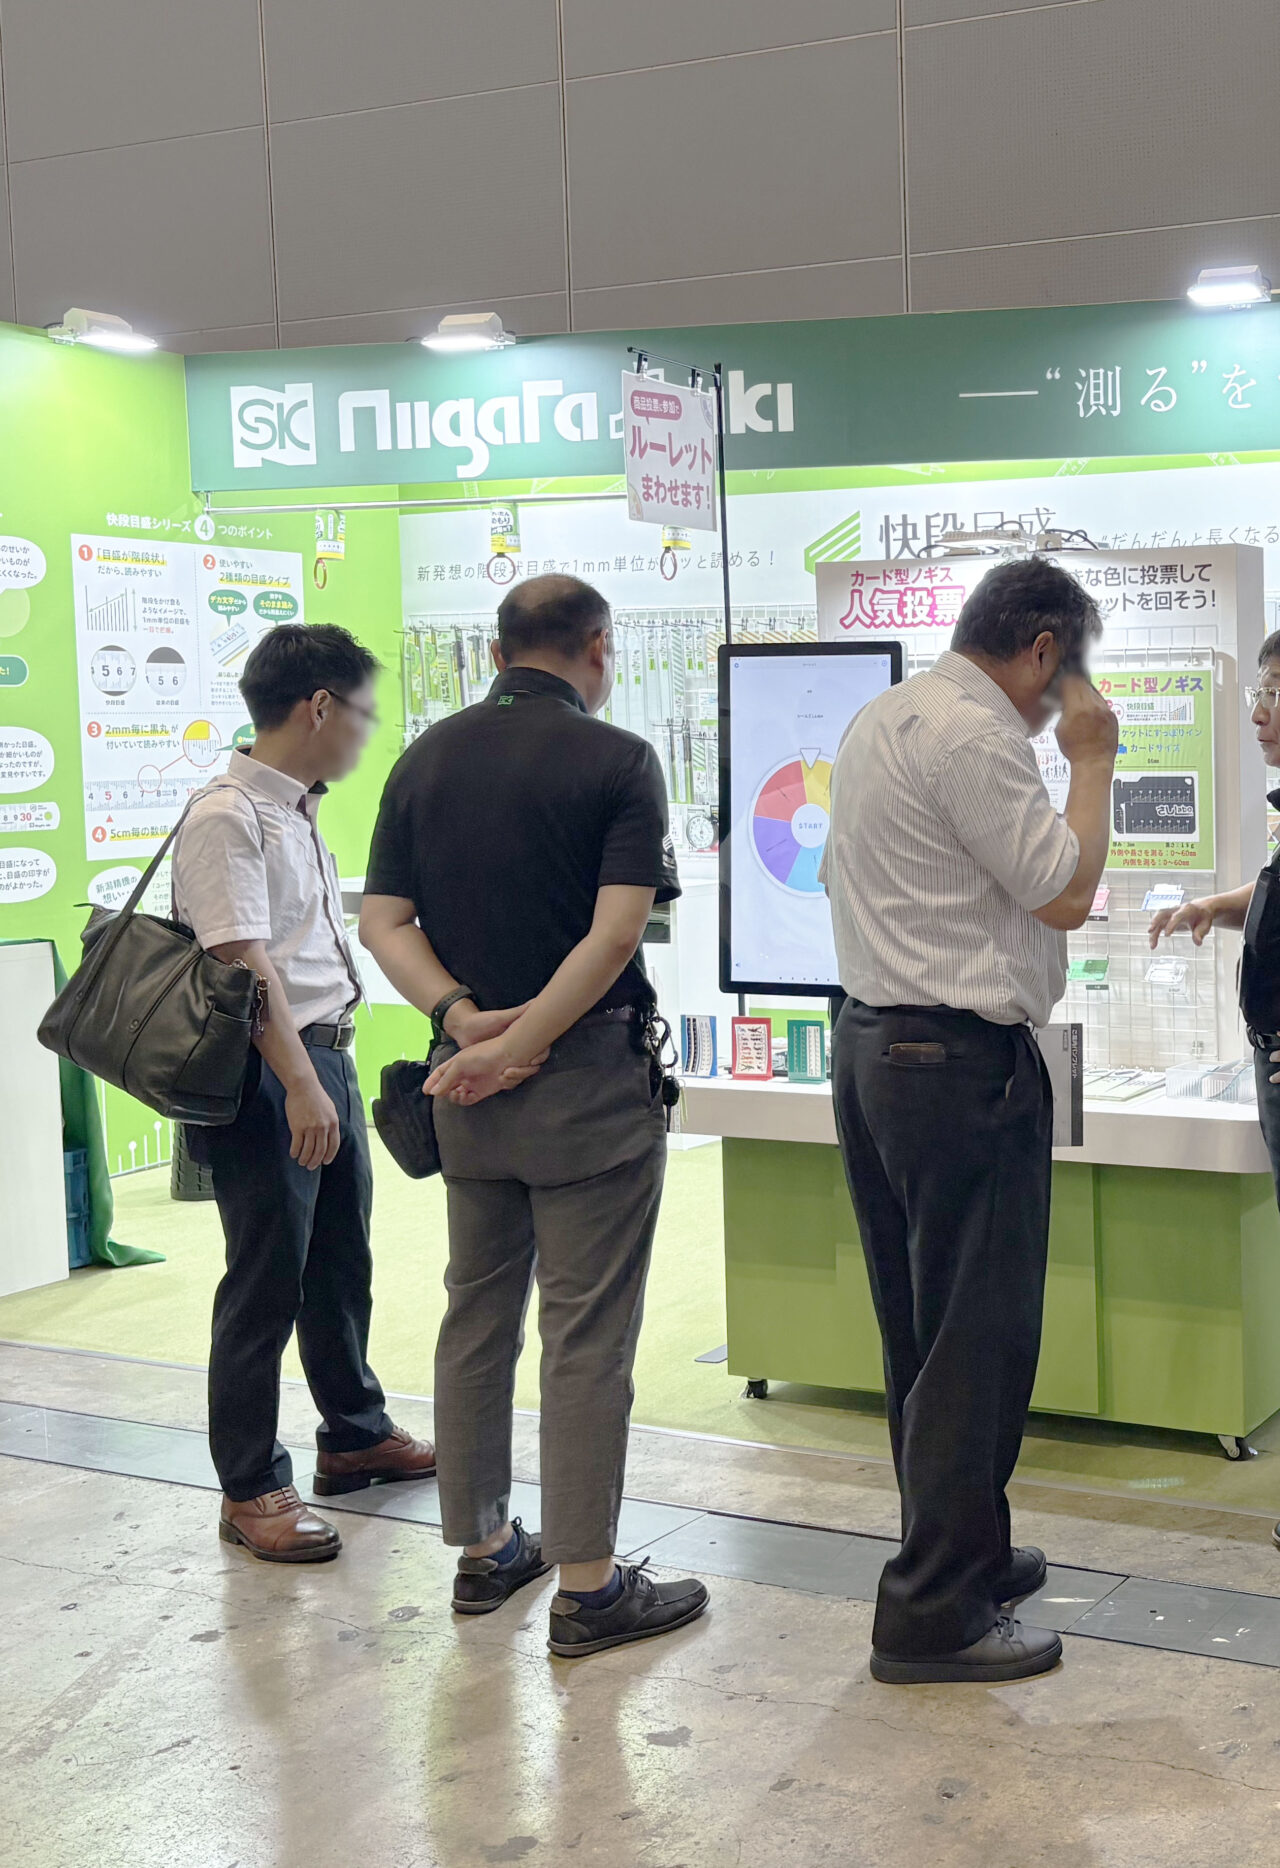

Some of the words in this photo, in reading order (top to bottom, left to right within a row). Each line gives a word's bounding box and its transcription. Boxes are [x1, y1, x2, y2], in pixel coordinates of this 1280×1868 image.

[629, 425, 713, 475] ルーレット
[106, 512, 192, 533] 快段目盛シリーズ
[200, 519, 209, 537] 4
[218, 524, 273, 540] つのポイント
[850, 566, 954, 587] カード型ノギス
[840, 585, 966, 630] 人気投票
[1098, 675, 1204, 694] カード型ノギス
[20, 812, 32, 822] 30
